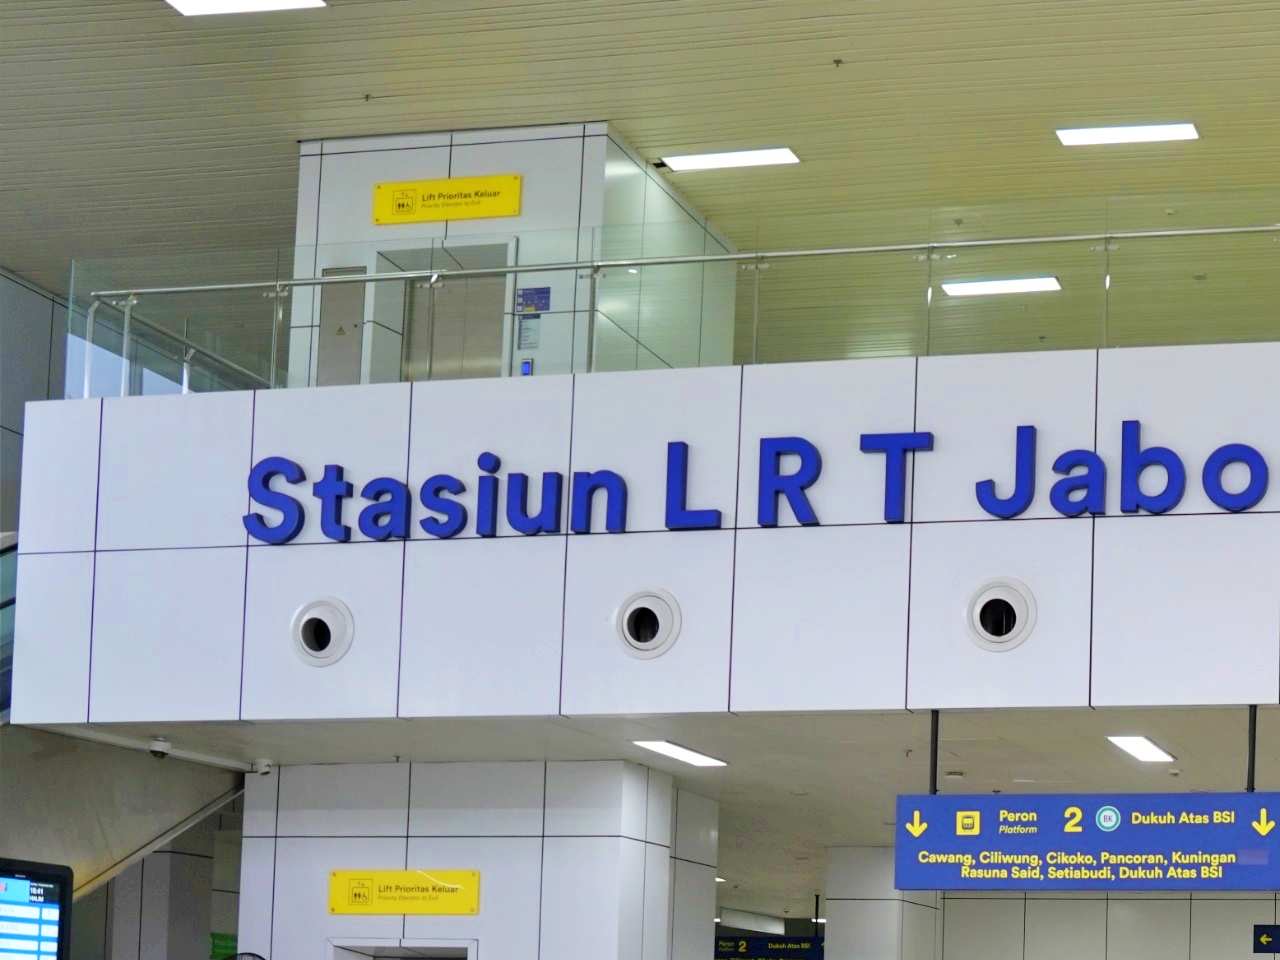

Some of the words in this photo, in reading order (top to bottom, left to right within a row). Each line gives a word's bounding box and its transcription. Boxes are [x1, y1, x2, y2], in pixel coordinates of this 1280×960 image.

[242, 452, 627, 544] Stasiun
[999, 809, 1038, 822] Peron
[1063, 806, 1083, 833] 2
[1131, 811, 1175, 824] Dukuh
[1178, 811, 1210, 824] Atas
[1212, 810, 1235, 824] BSI
[999, 824, 1038, 835] Platform
[918, 851, 976, 867] Cawang,
[979, 851, 1043, 867] Ciliwung,
[1046, 851, 1097, 866] Cikoko,
[1100, 852, 1168, 866] Pancoran,
[1171, 851, 1236, 867] Kuningan
[960, 866, 1008, 879] Rasuna
[1011, 866, 1044, 880] Said,
[1047, 866, 1116, 880] Setiabudi,
[1119, 866, 1163, 879] Dukuh
[1166, 866, 1197, 879] Atas
[1200, 866, 1223, 879] BSI
[378, 884, 393, 893] Lift
[395, 884, 429, 894] Prioritas
[738, 940, 748, 952] 2
